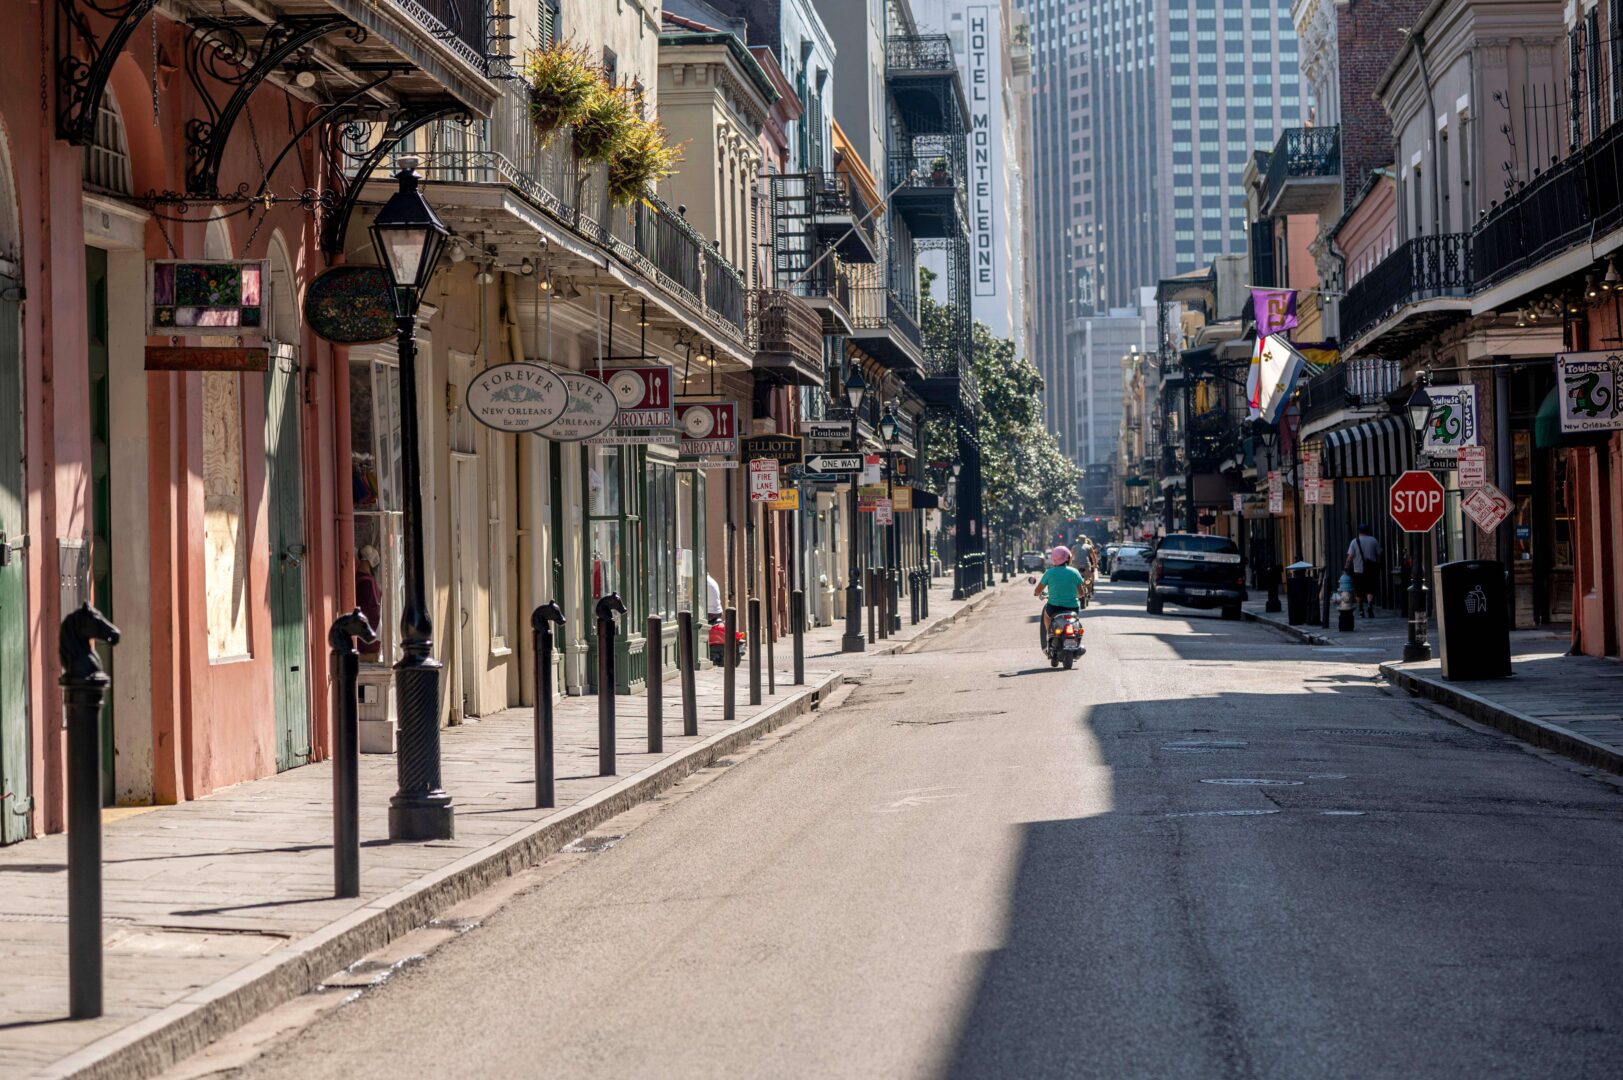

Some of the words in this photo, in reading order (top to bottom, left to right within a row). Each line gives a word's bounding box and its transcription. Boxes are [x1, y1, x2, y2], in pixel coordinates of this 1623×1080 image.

[972, 18, 987, 101] HOTEL
[973, 114, 991, 283] MONTELEONE
[1566, 363, 1608, 374] Toulouse
[481, 370, 553, 393] FOREVER
[567, 380, 603, 404] EVER
[1431, 396, 1459, 405] Toulouse
[557, 417, 602, 426] ORLEANS
[621, 412, 670, 426] ROYALE
[1465, 397, 1473, 437] Royale
[810, 429, 849, 437] Toulouse
[694, 441, 735, 453] ROYALE
[748, 441, 795, 451] ELLIOTT
[751, 462, 760, 471] NO
[821, 460, 838, 468] ONE
[840, 459, 858, 467] WAY
[1428, 458, 1456, 468] Toulo
[757, 473, 772, 481] FIRE
[756, 482, 773, 490] LANE
[1393, 490, 1441, 513] STOP
